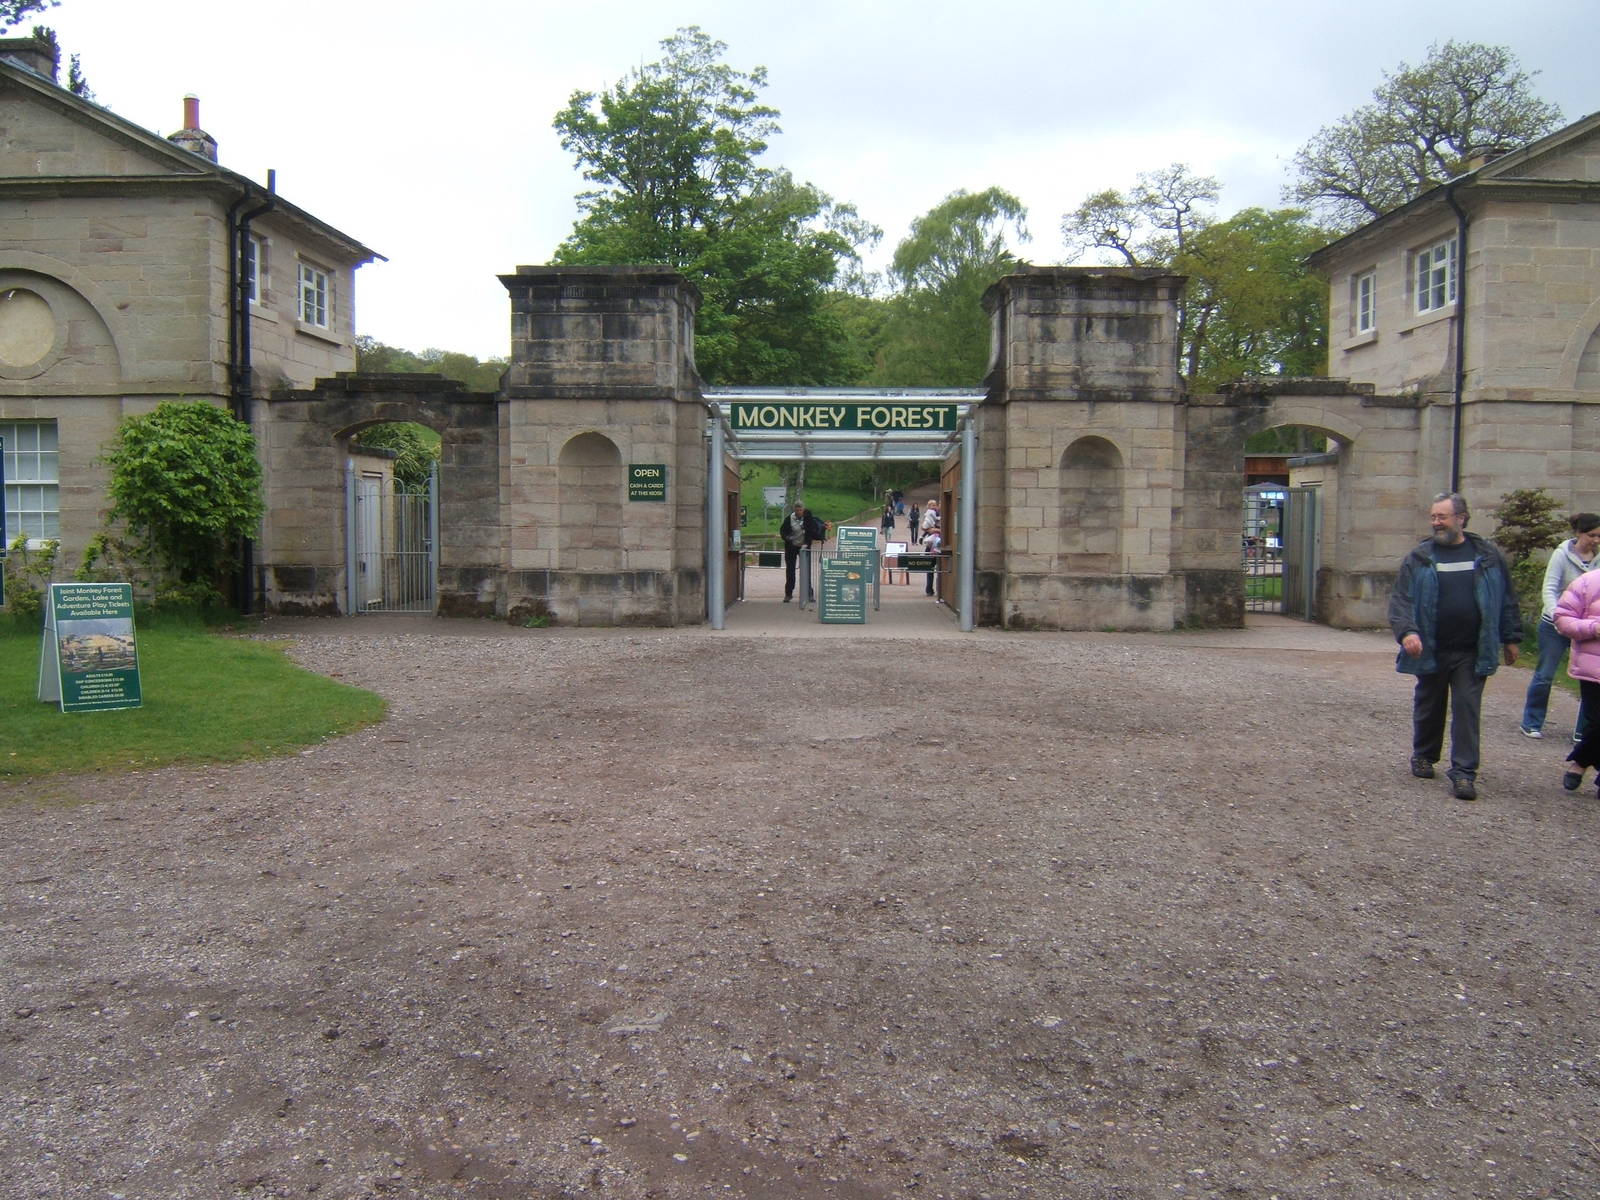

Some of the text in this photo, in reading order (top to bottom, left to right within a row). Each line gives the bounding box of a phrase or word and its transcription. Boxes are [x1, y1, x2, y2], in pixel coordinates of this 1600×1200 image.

[738, 406, 949, 428] MONKEY FOREST
[634, 469, 660, 477] OPEN
